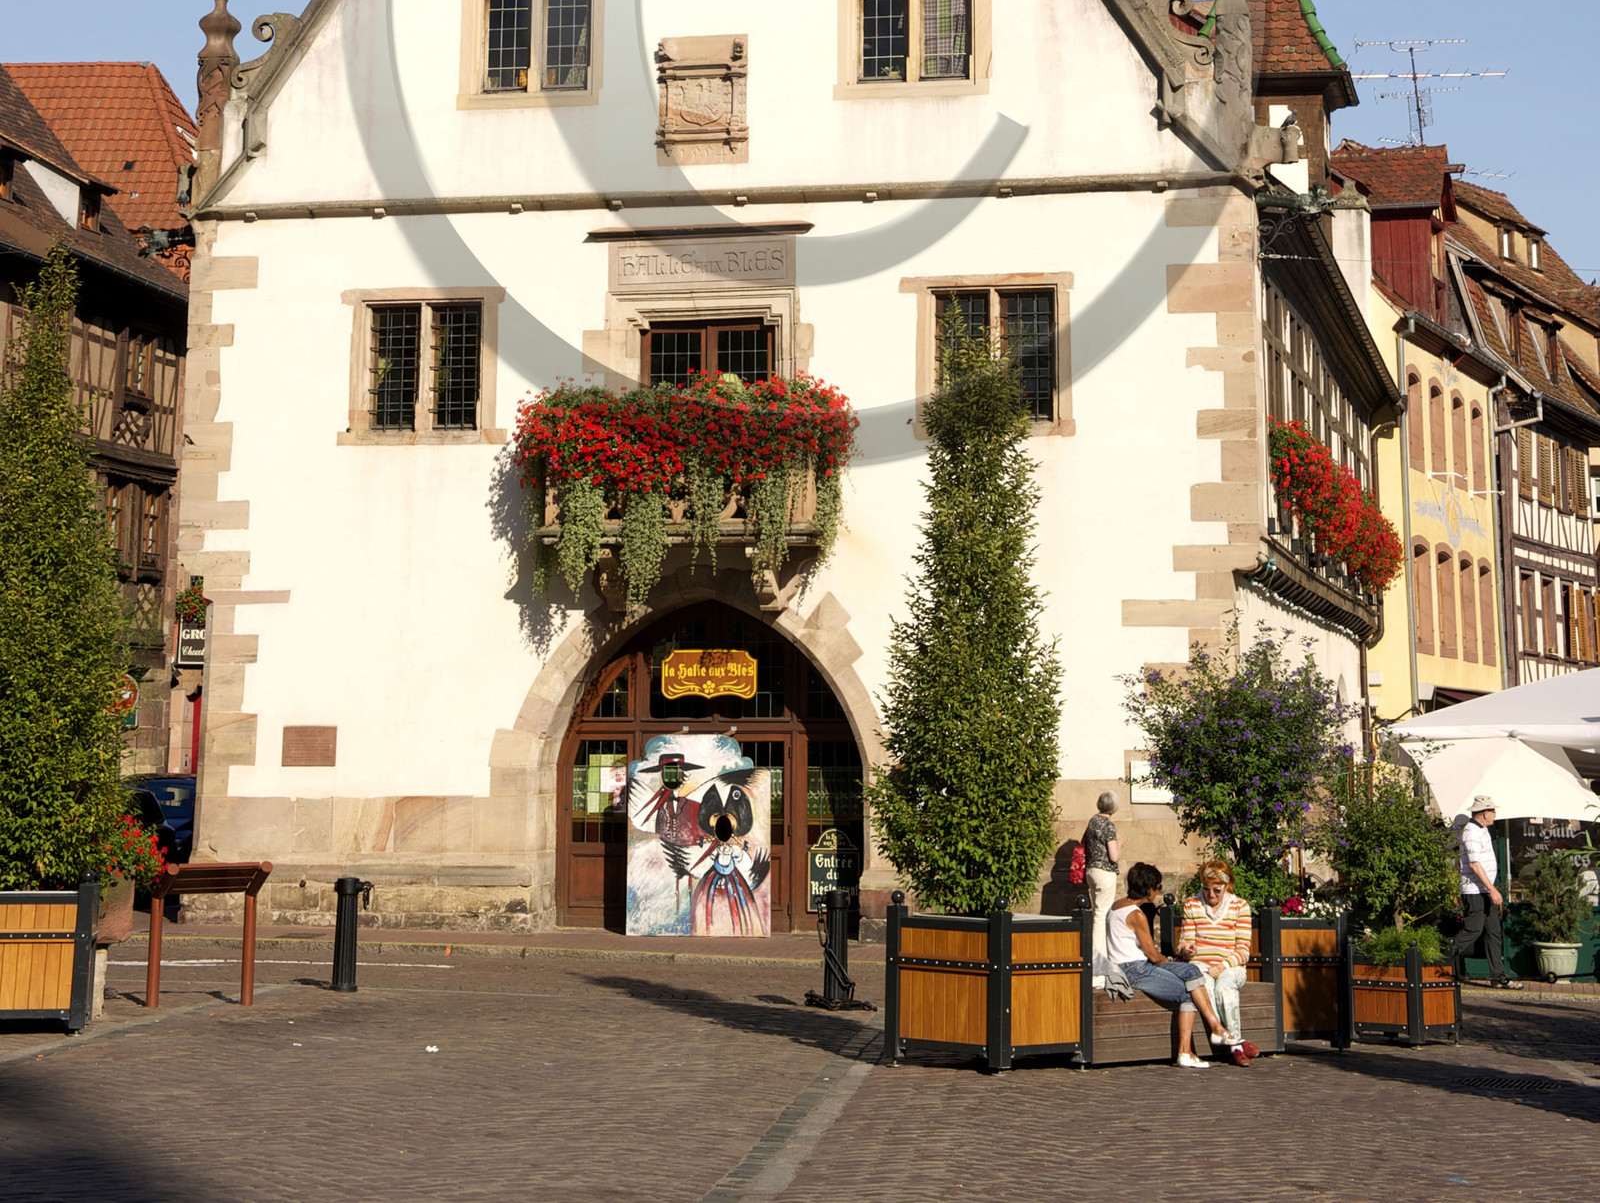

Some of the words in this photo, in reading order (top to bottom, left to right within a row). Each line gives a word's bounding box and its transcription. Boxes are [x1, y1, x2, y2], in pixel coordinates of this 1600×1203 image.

[618, 251, 695, 277] HALLE
[664, 663, 675, 677] la
[678, 662, 706, 679] Halle
[709, 666, 725, 678] aux
[728, 662, 754, 677] Blés
[815, 853, 853, 868] Entrée
